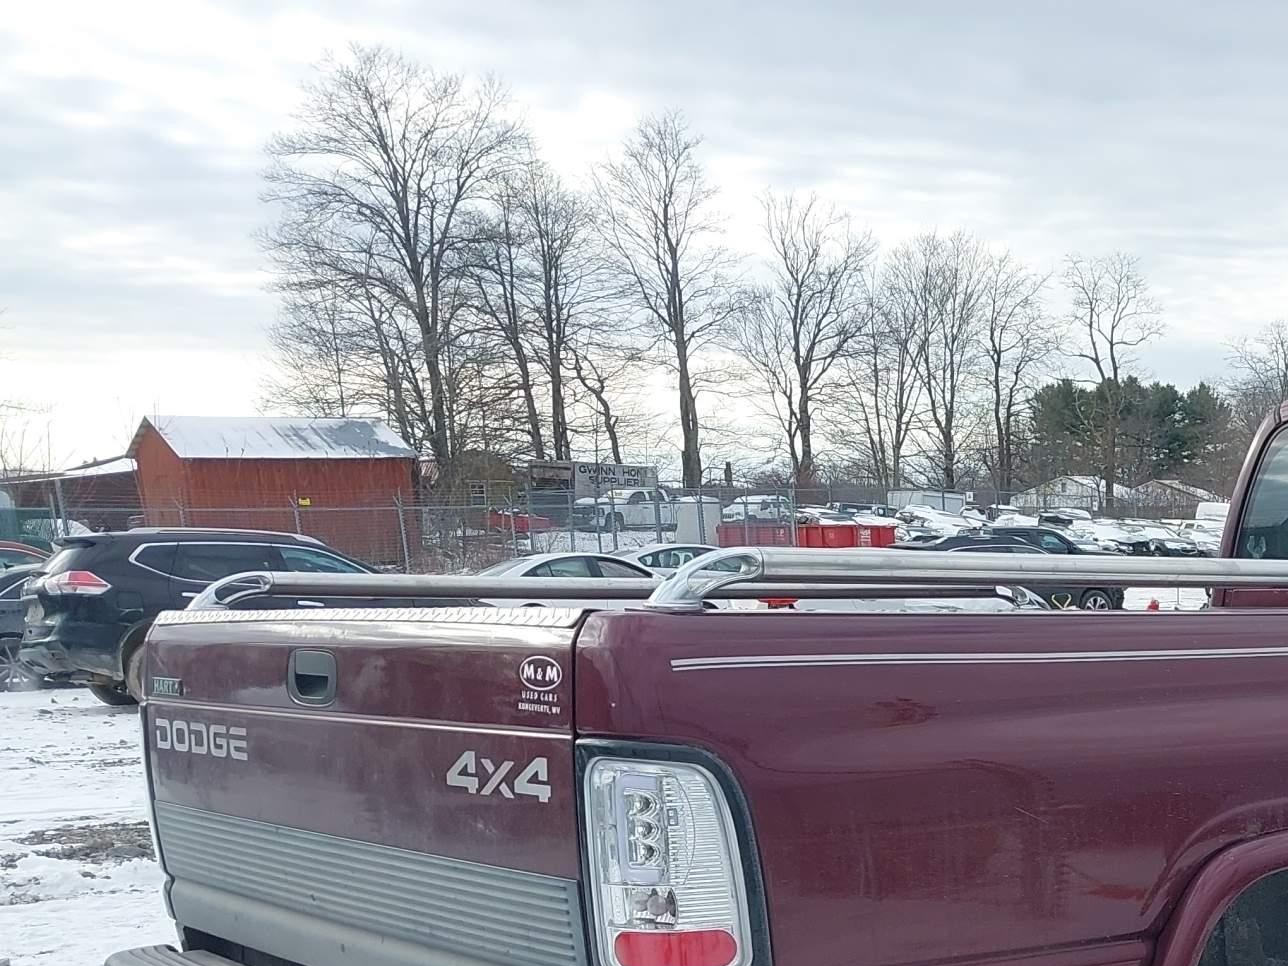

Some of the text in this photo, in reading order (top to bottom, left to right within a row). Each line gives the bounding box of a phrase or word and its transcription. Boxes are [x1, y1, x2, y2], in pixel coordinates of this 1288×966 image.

[521, 690, 557, 702] USED CARS
[155, 718, 248, 761] DODGE
